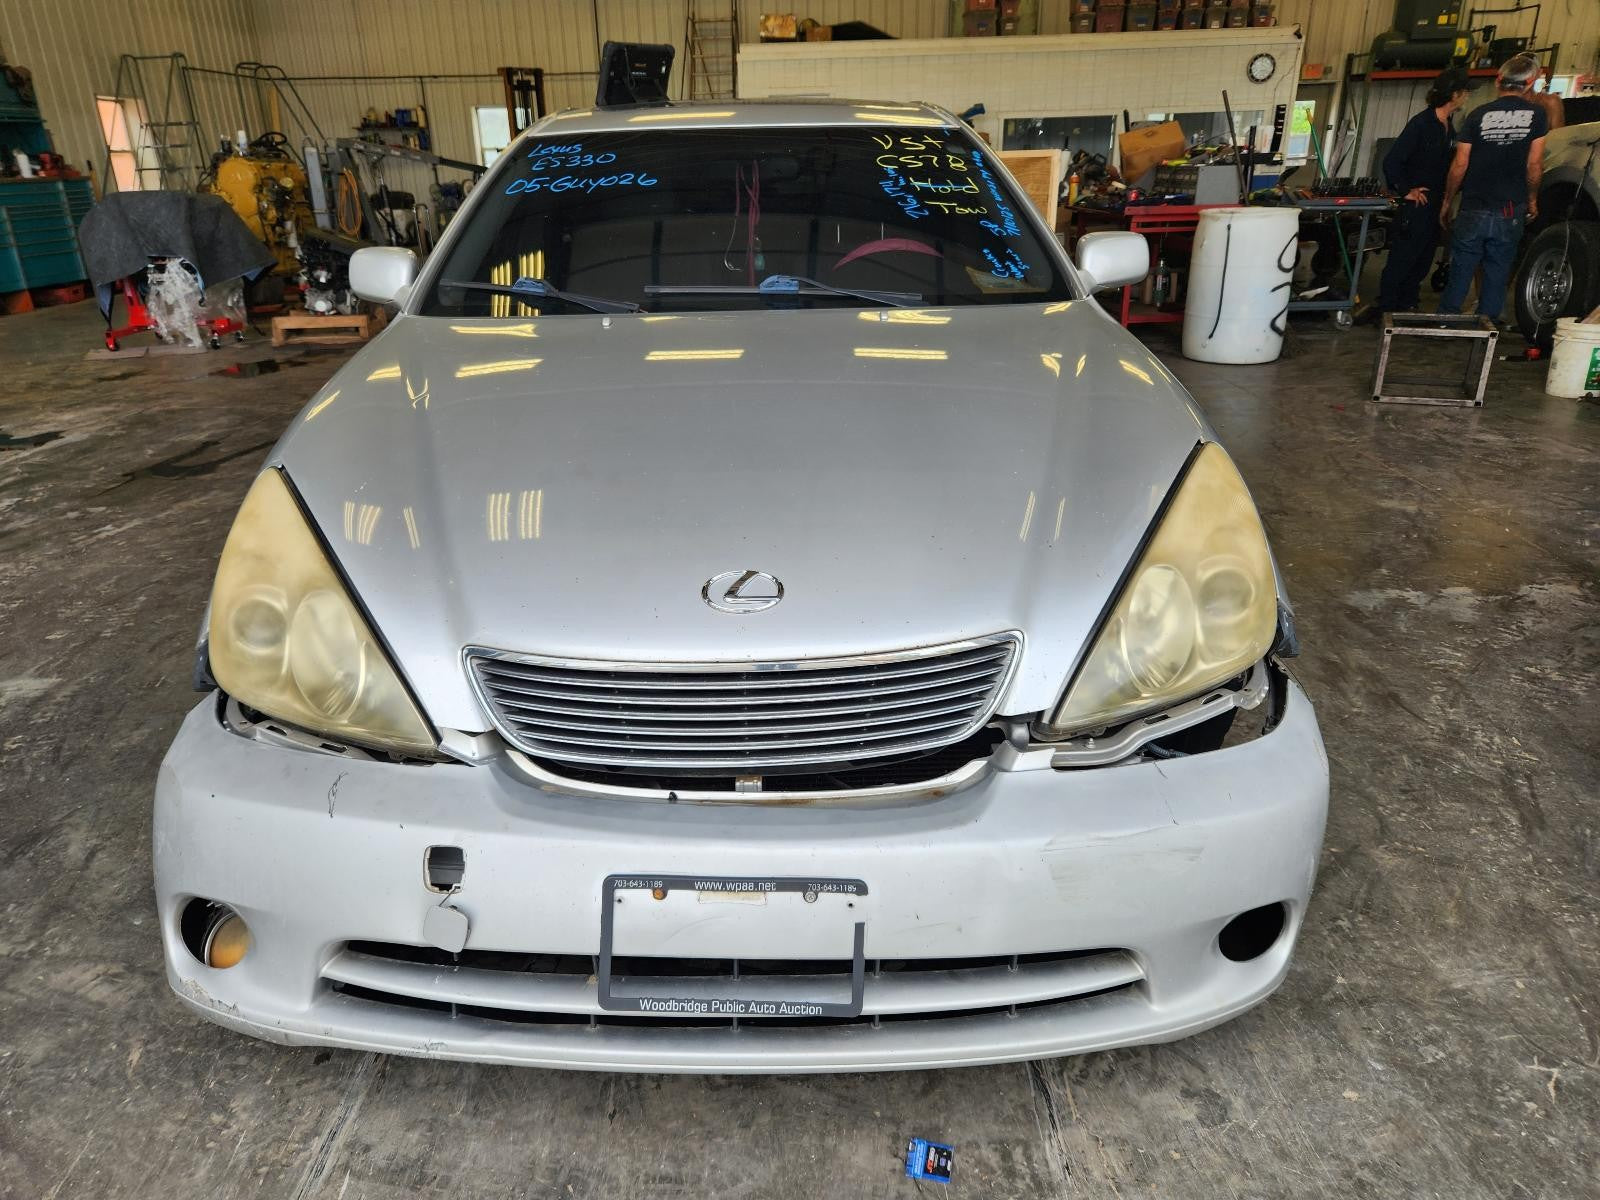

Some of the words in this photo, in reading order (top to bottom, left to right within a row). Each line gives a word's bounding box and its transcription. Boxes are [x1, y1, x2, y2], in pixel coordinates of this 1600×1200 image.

[924, 200, 988, 214] Tow
[613, 879, 663, 888] 703-643-1189
[807, 883, 857, 892] 703-643-1189
[639, 998, 708, 1014] Woodbridge
[711, 1000, 746, 1014] Public
[748, 1001, 776, 1014] Auto
[778, 1002, 823, 1015] Auction
